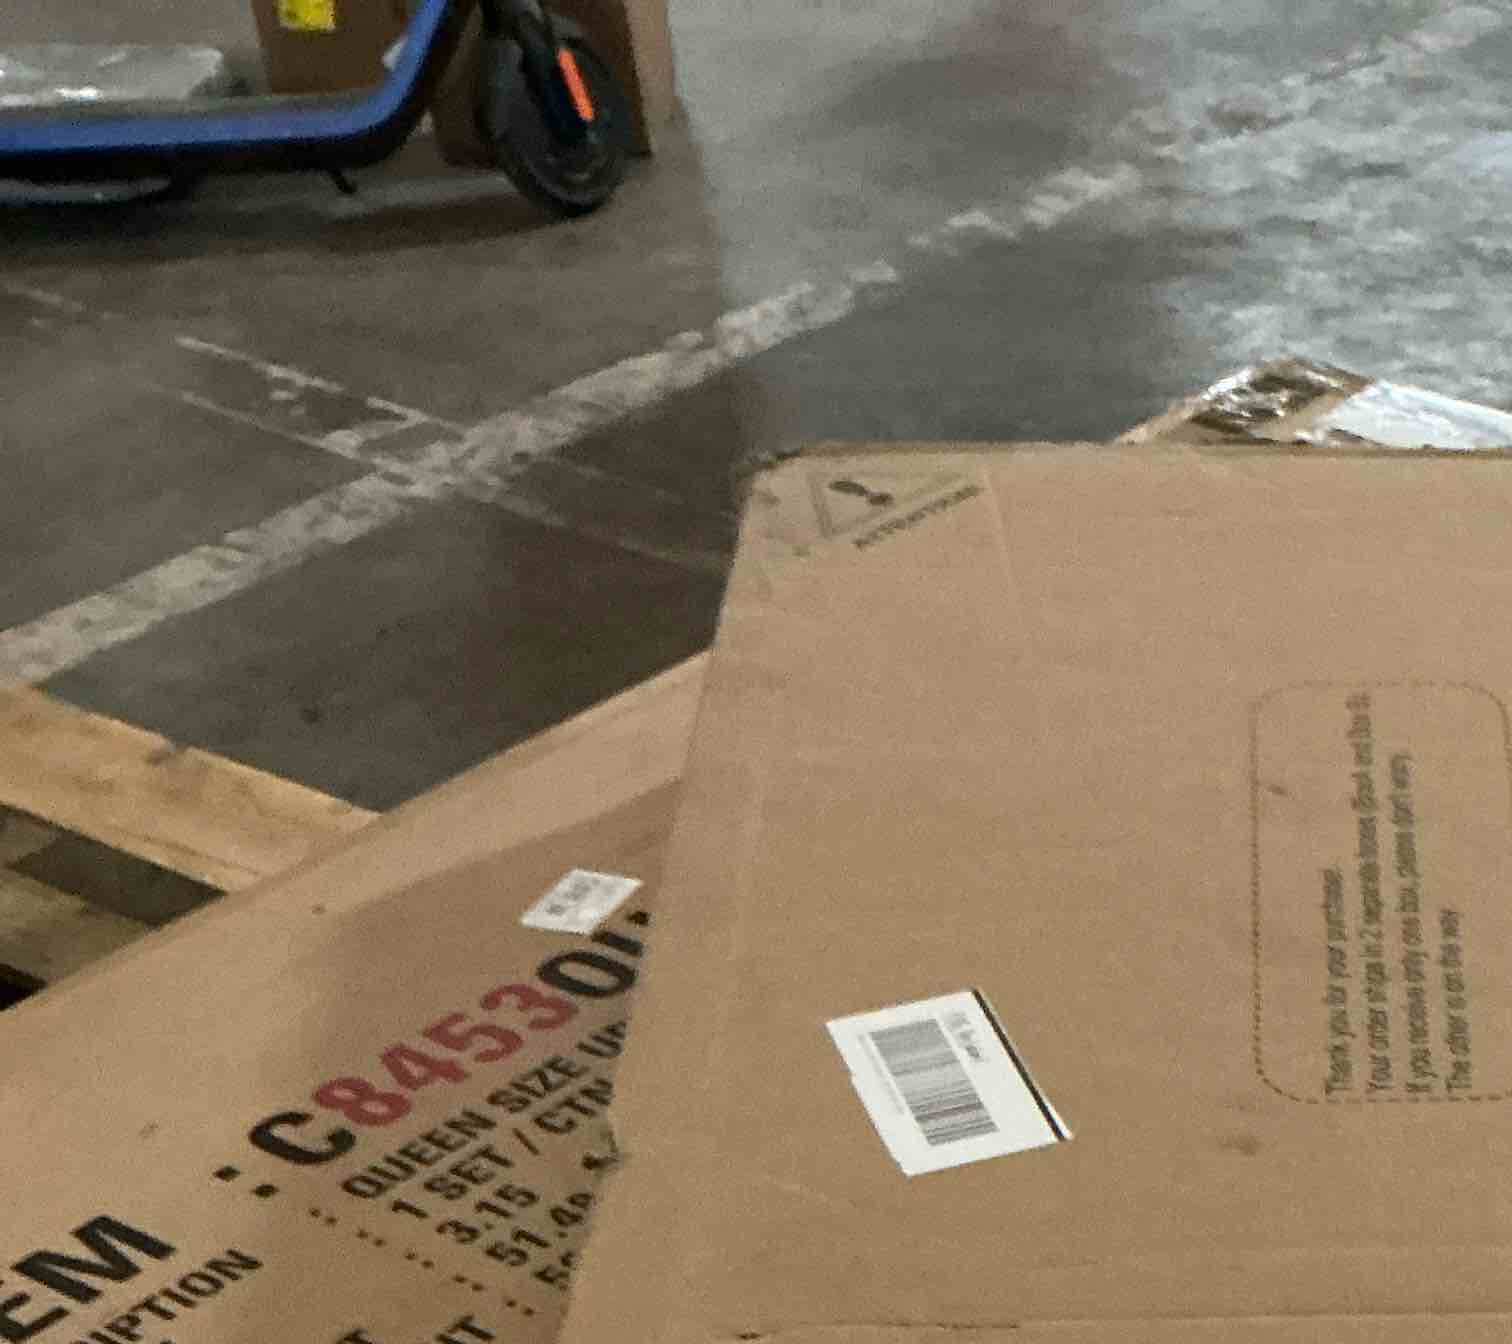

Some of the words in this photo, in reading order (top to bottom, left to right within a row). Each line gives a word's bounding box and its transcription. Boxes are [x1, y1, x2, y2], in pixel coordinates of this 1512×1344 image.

[341, 1107, 498, 1200] QUEEN
[487, 1055, 592, 1114] SIZE
[422, 1143, 515, 1201] SET
[435, 1183, 541, 1245] 3.15
